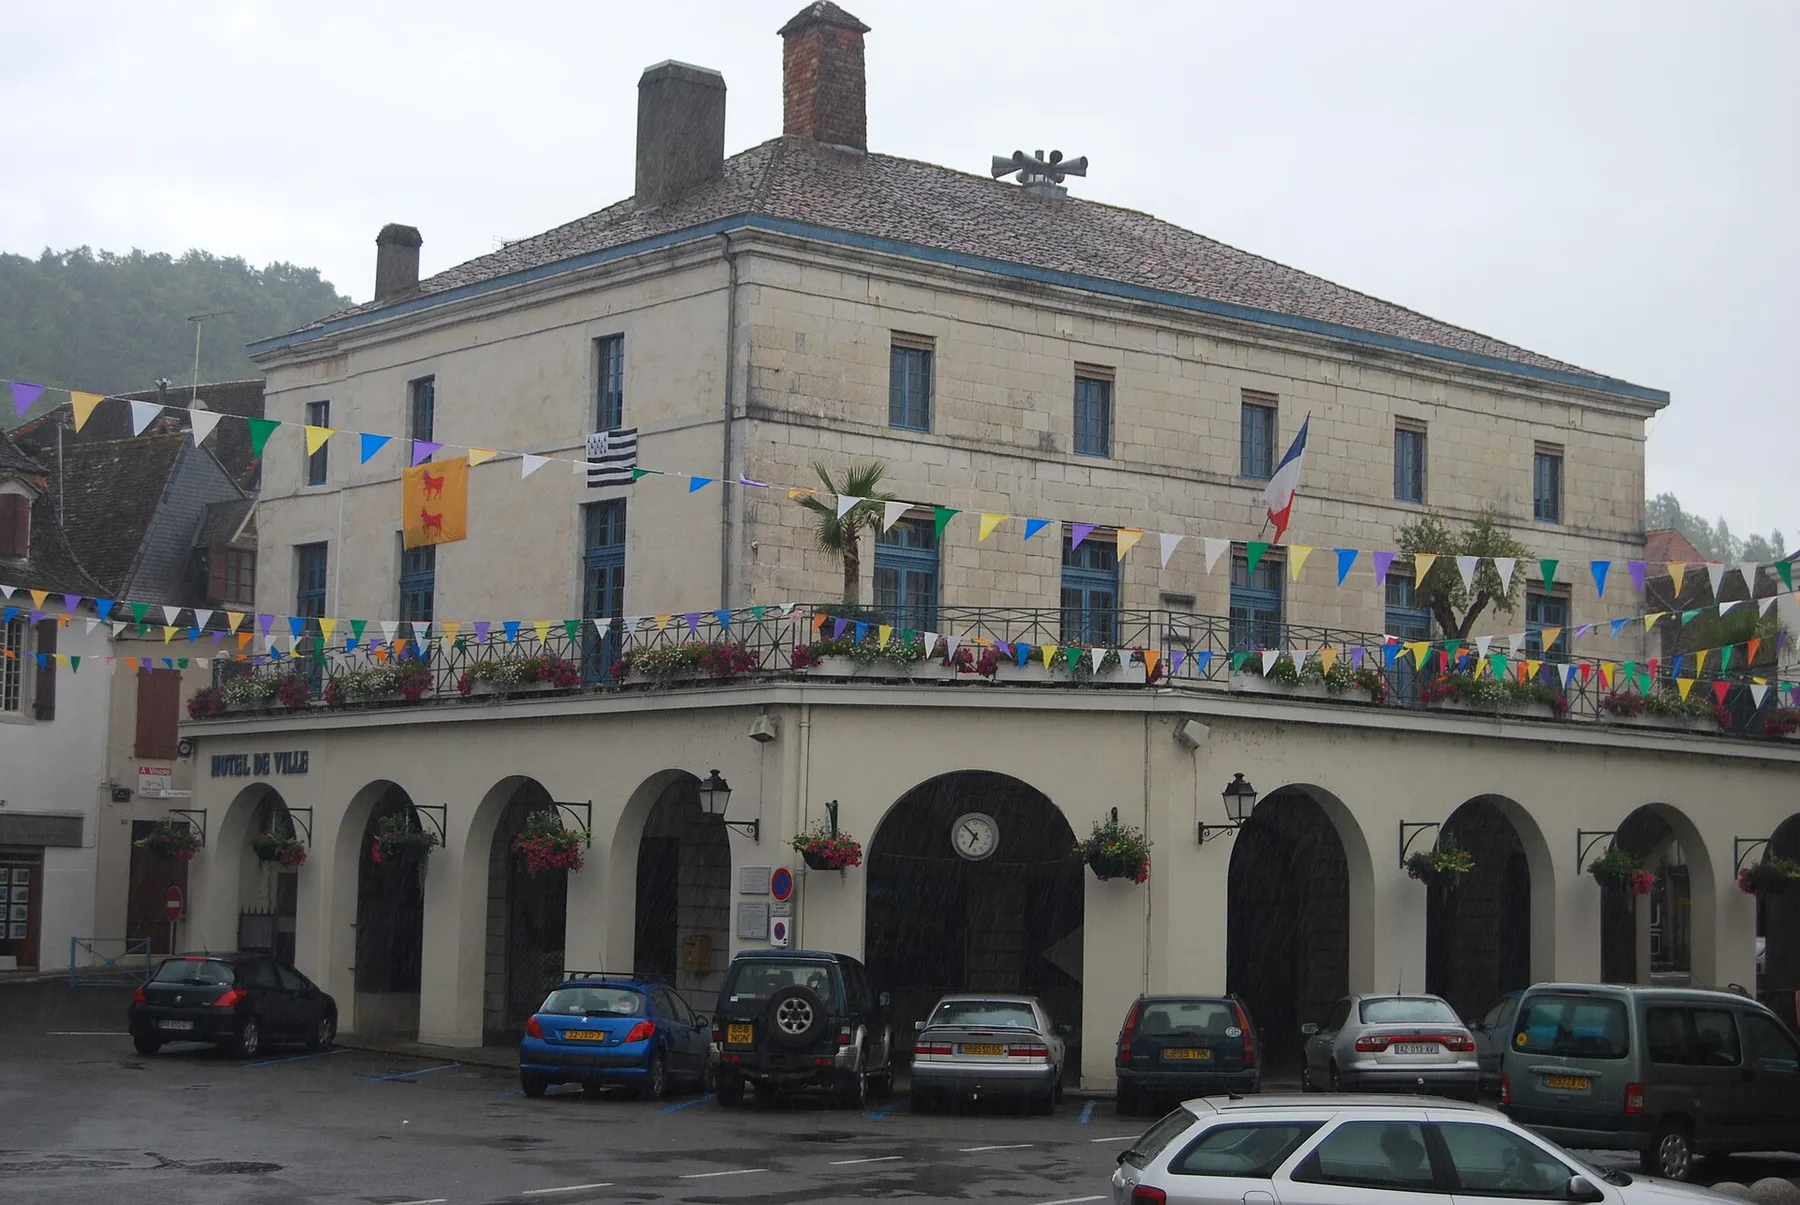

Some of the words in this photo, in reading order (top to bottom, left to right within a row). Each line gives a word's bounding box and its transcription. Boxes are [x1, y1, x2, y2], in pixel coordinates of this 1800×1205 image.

[140, 766, 146, 774] A
[253, 752, 271, 776] DE
[273, 750, 309, 775] VILLE
